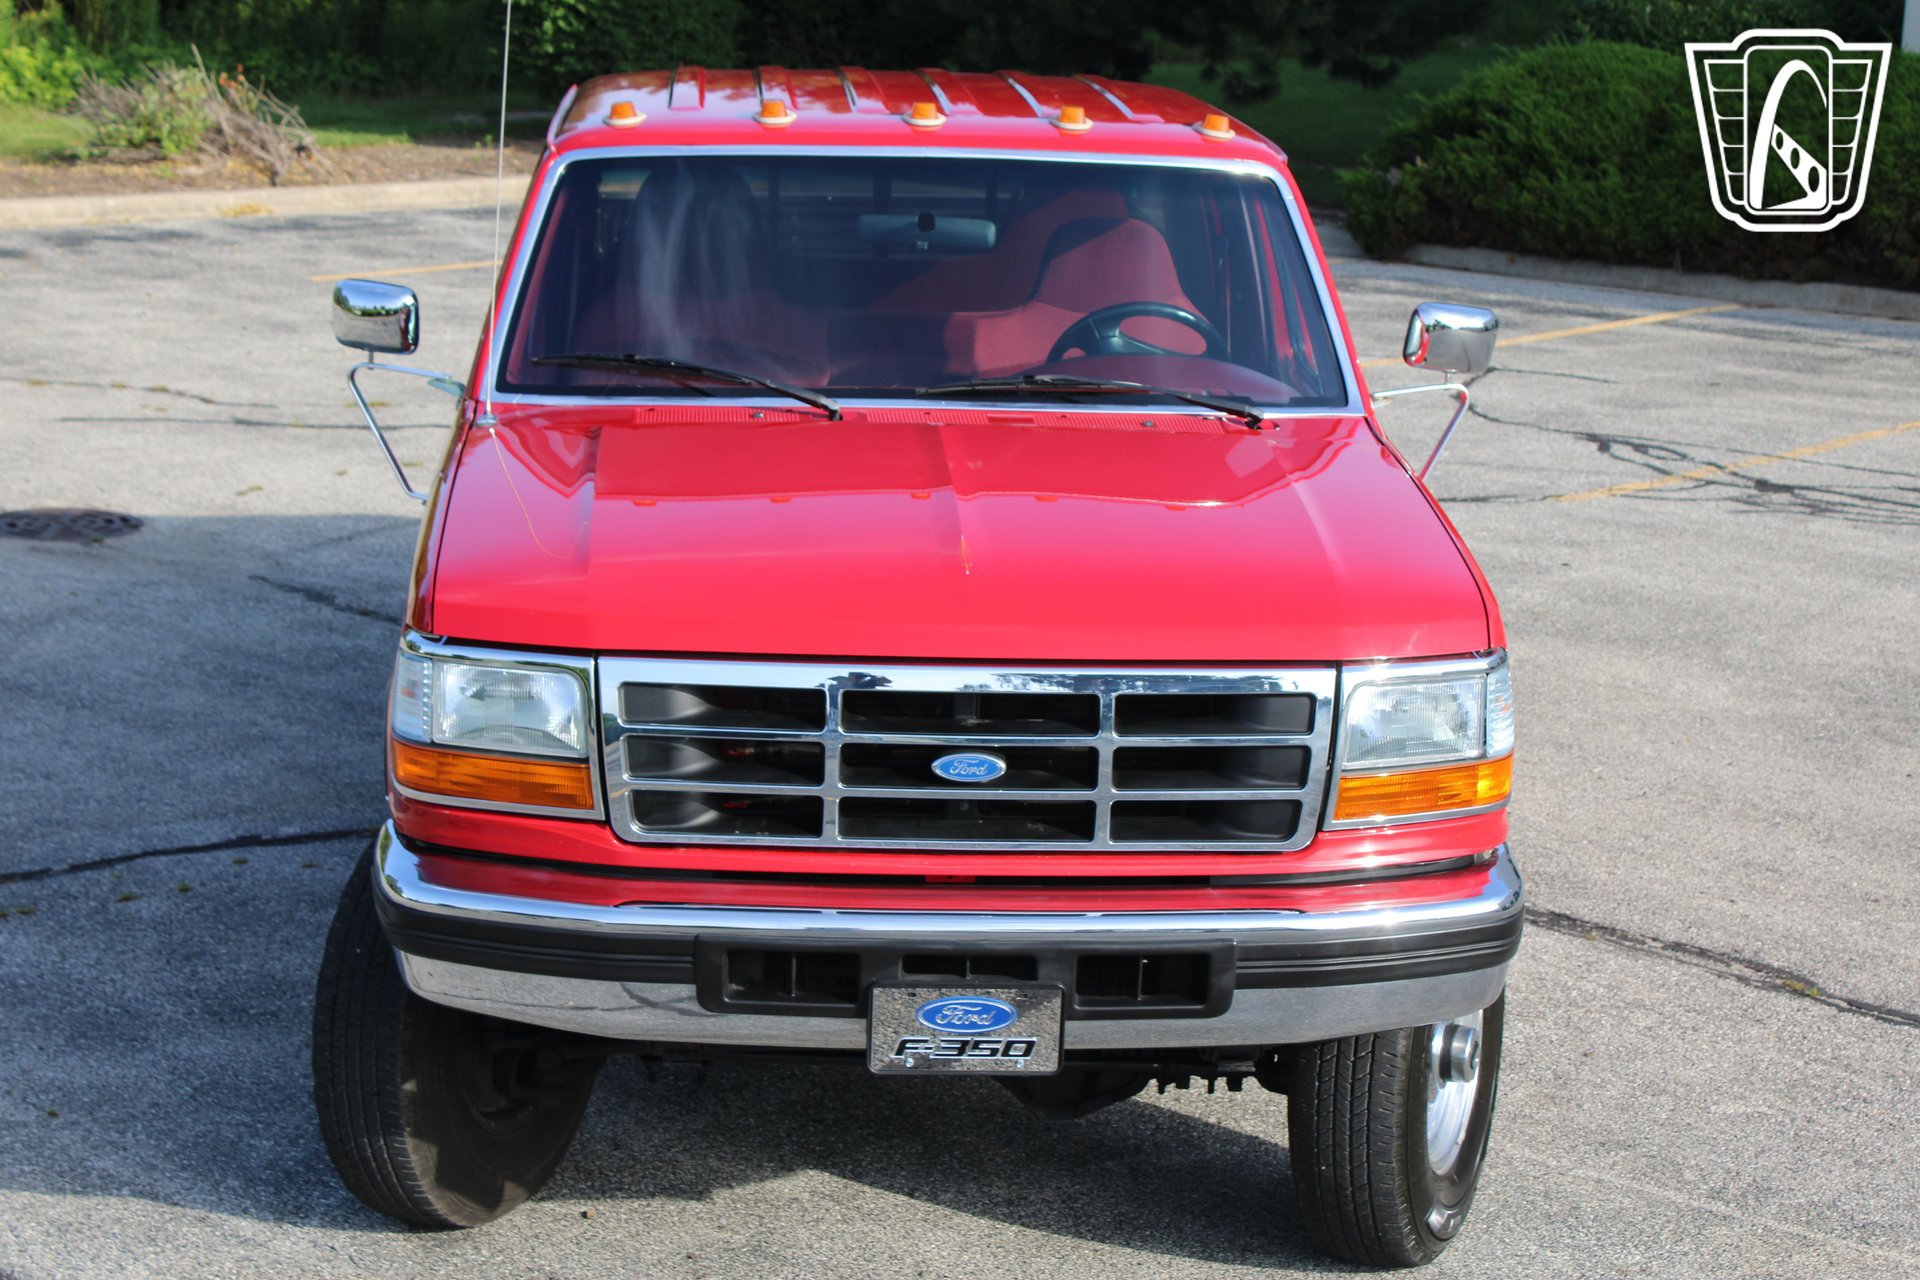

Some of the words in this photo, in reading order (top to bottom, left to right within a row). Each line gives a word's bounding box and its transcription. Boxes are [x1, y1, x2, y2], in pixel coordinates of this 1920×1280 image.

[949, 757, 989, 776] Ford
[935, 1004, 997, 1026] Ford
[891, 1036, 1037, 1060] F-350
